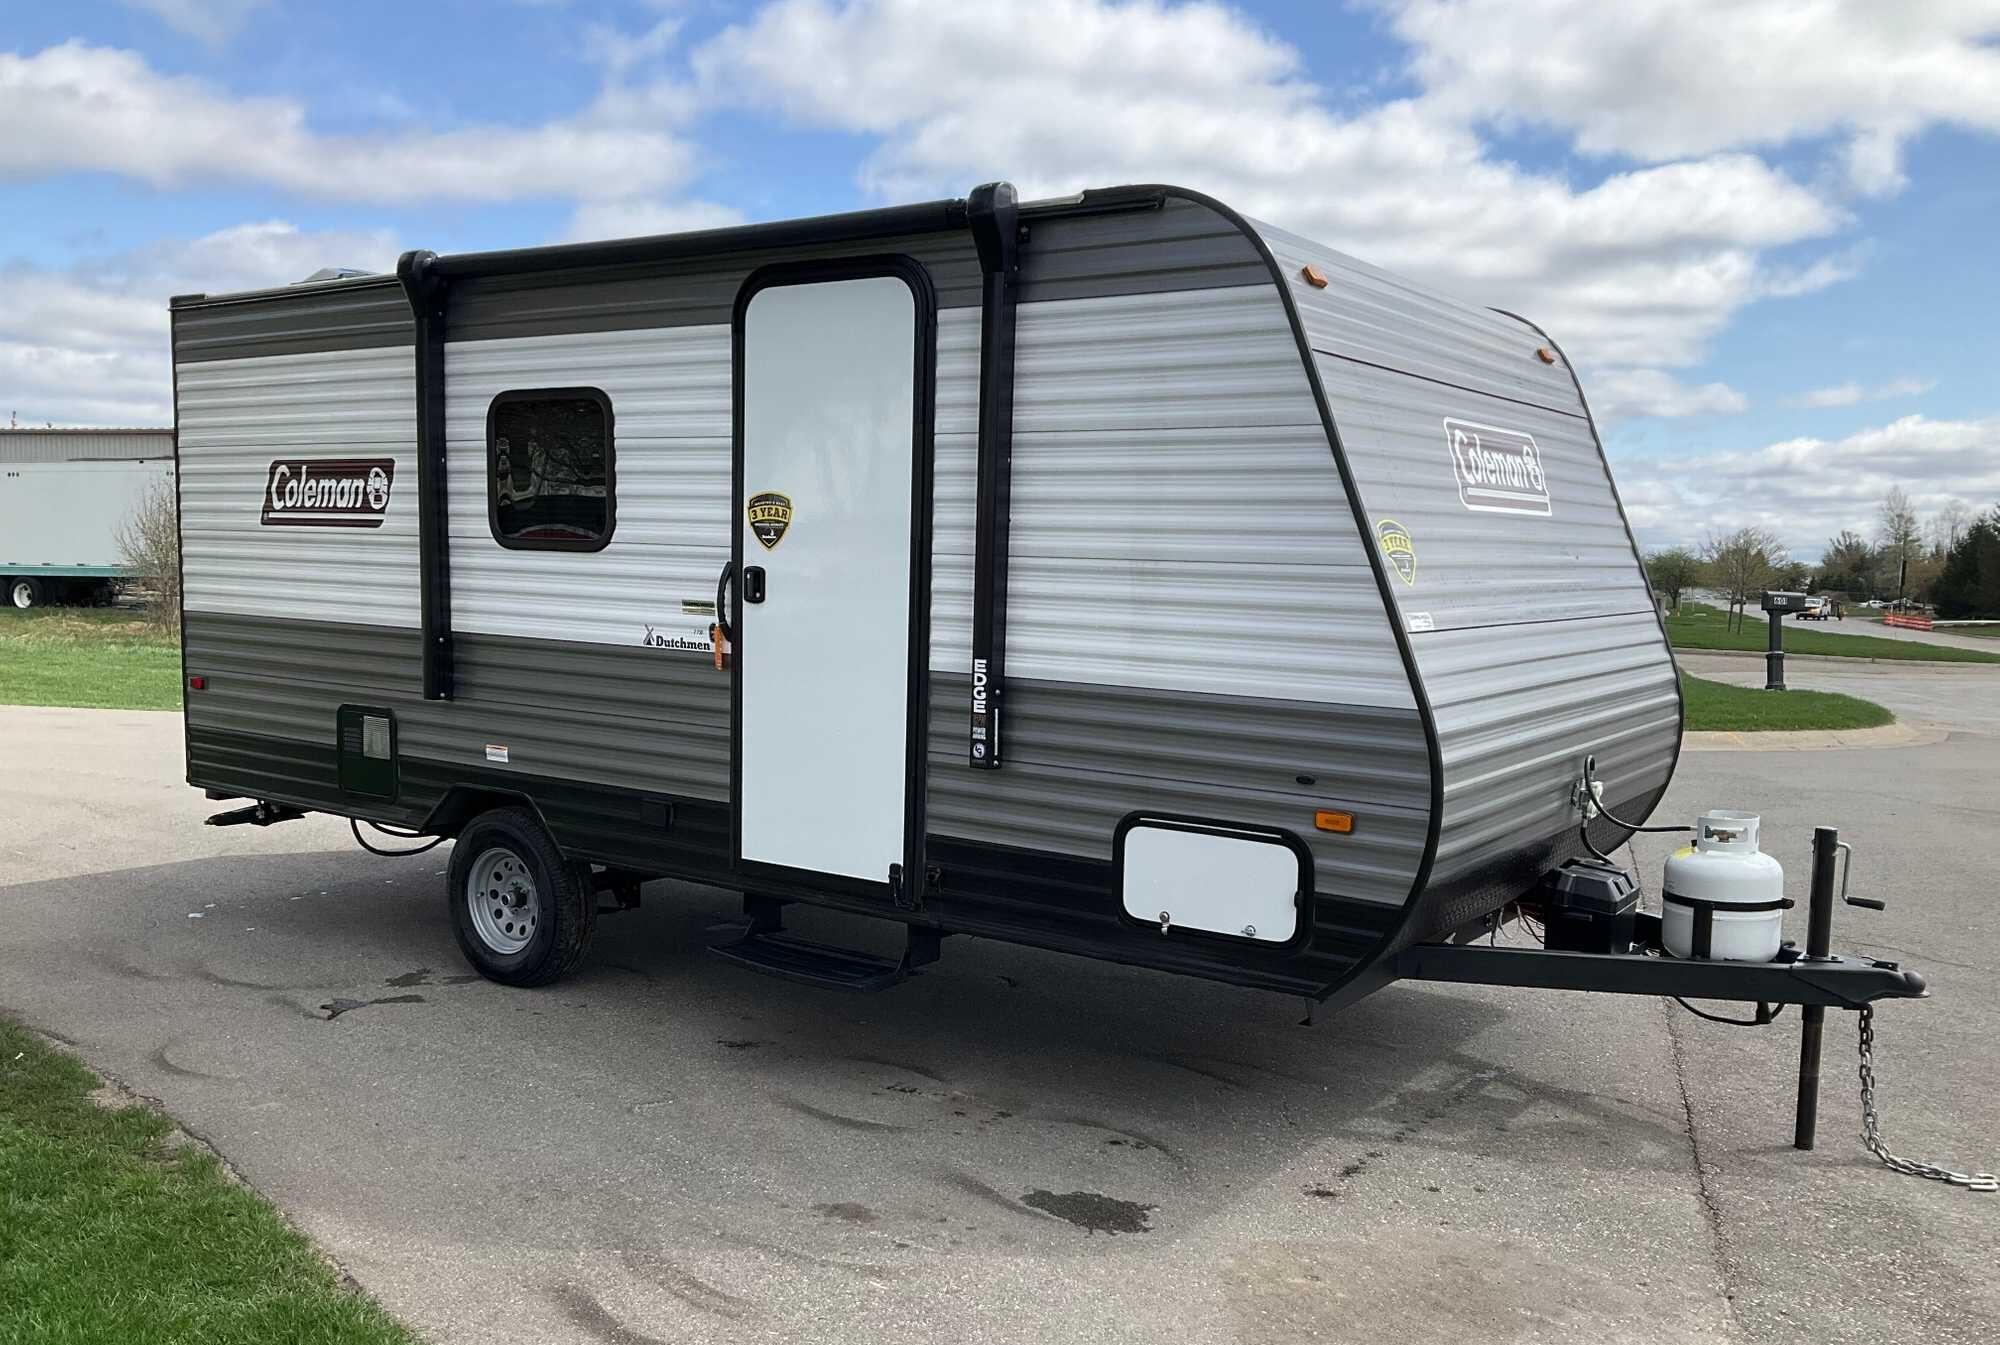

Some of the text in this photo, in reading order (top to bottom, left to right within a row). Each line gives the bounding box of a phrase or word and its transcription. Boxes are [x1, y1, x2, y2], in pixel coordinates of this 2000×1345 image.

[1454, 429, 1530, 489] Coleman
[271, 464, 365, 510] Coleman
[751, 506, 788, 520] 3 YEAR
[655, 635, 711, 651] Dutchmen
[973, 659, 987, 714] EDGE
